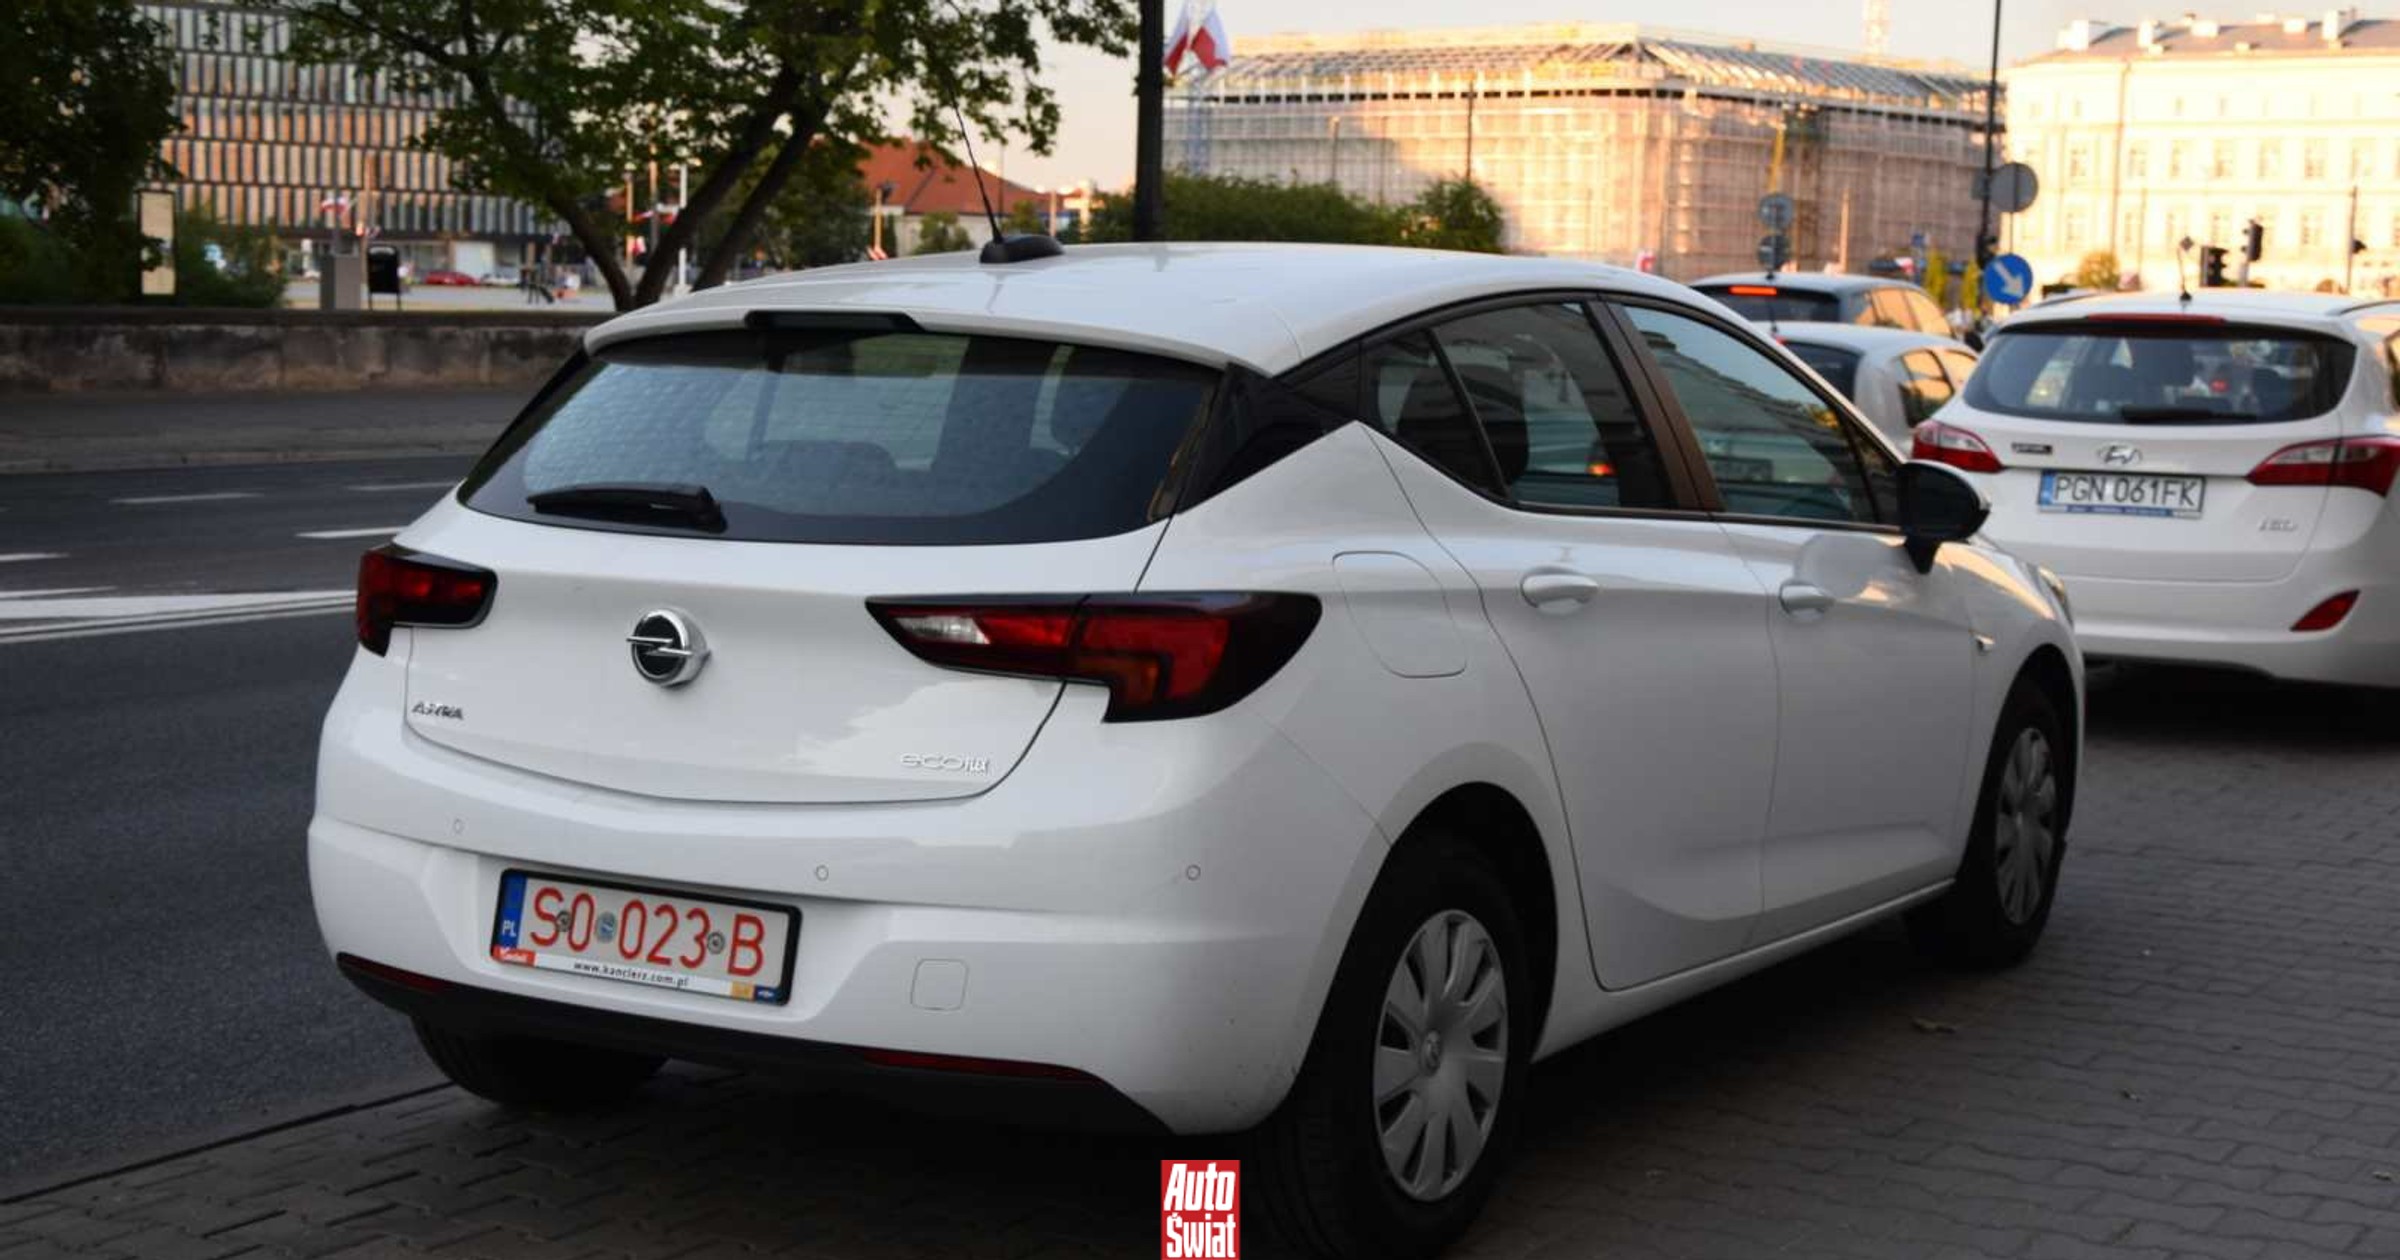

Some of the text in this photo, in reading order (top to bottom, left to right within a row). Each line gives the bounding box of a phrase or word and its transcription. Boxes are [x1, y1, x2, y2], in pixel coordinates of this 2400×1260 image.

[2054, 476, 2198, 507] PGN 061FK
[502, 919, 517, 937] PL
[617, 899, 712, 971] 023
[727, 913, 766, 978] B
